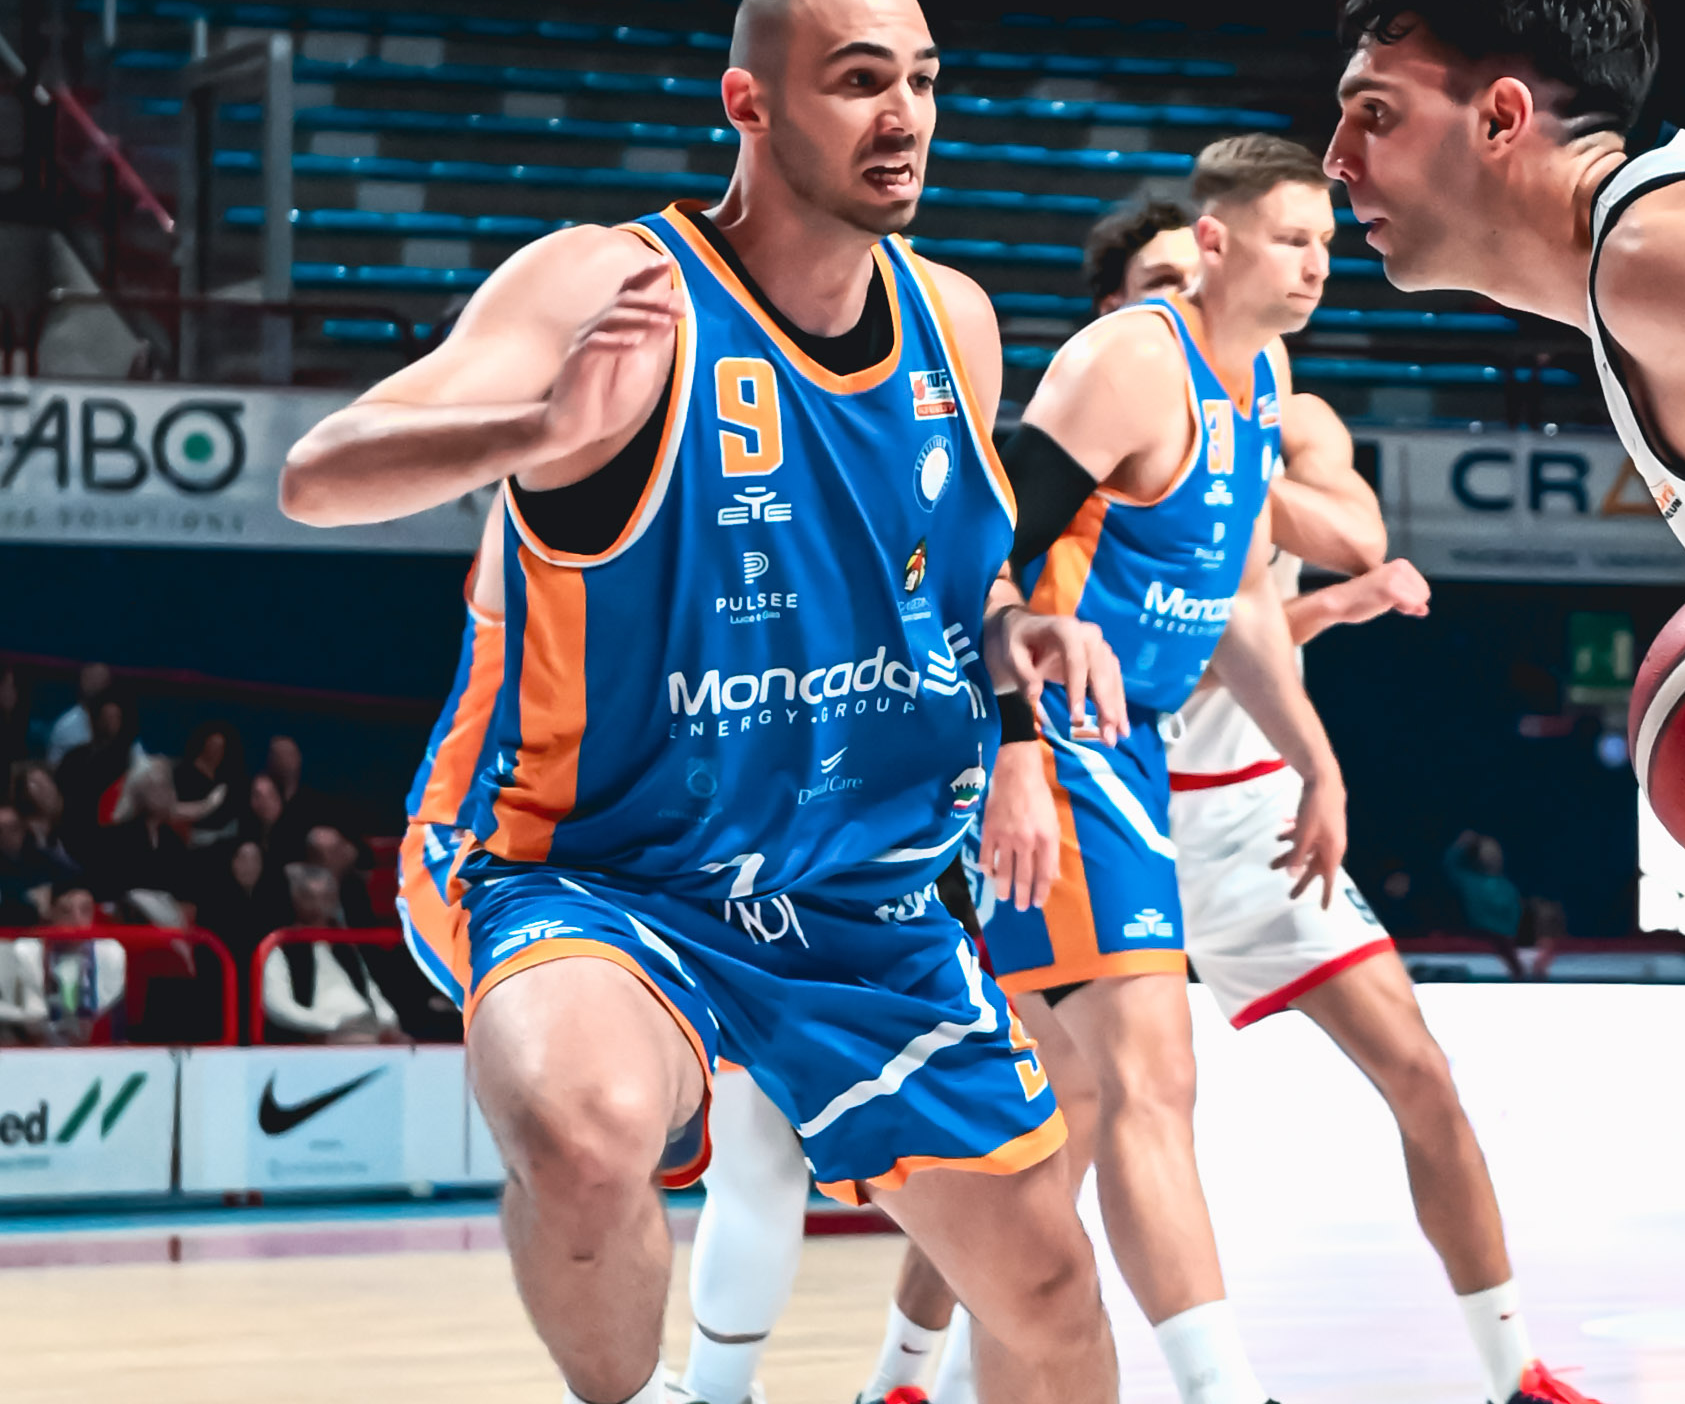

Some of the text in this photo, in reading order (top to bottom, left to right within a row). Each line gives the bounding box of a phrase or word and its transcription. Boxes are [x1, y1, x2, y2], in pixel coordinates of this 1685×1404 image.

[714, 357, 783, 477] 9
[715, 593, 798, 613] PULSEE
[668, 646, 920, 716] Moncada
